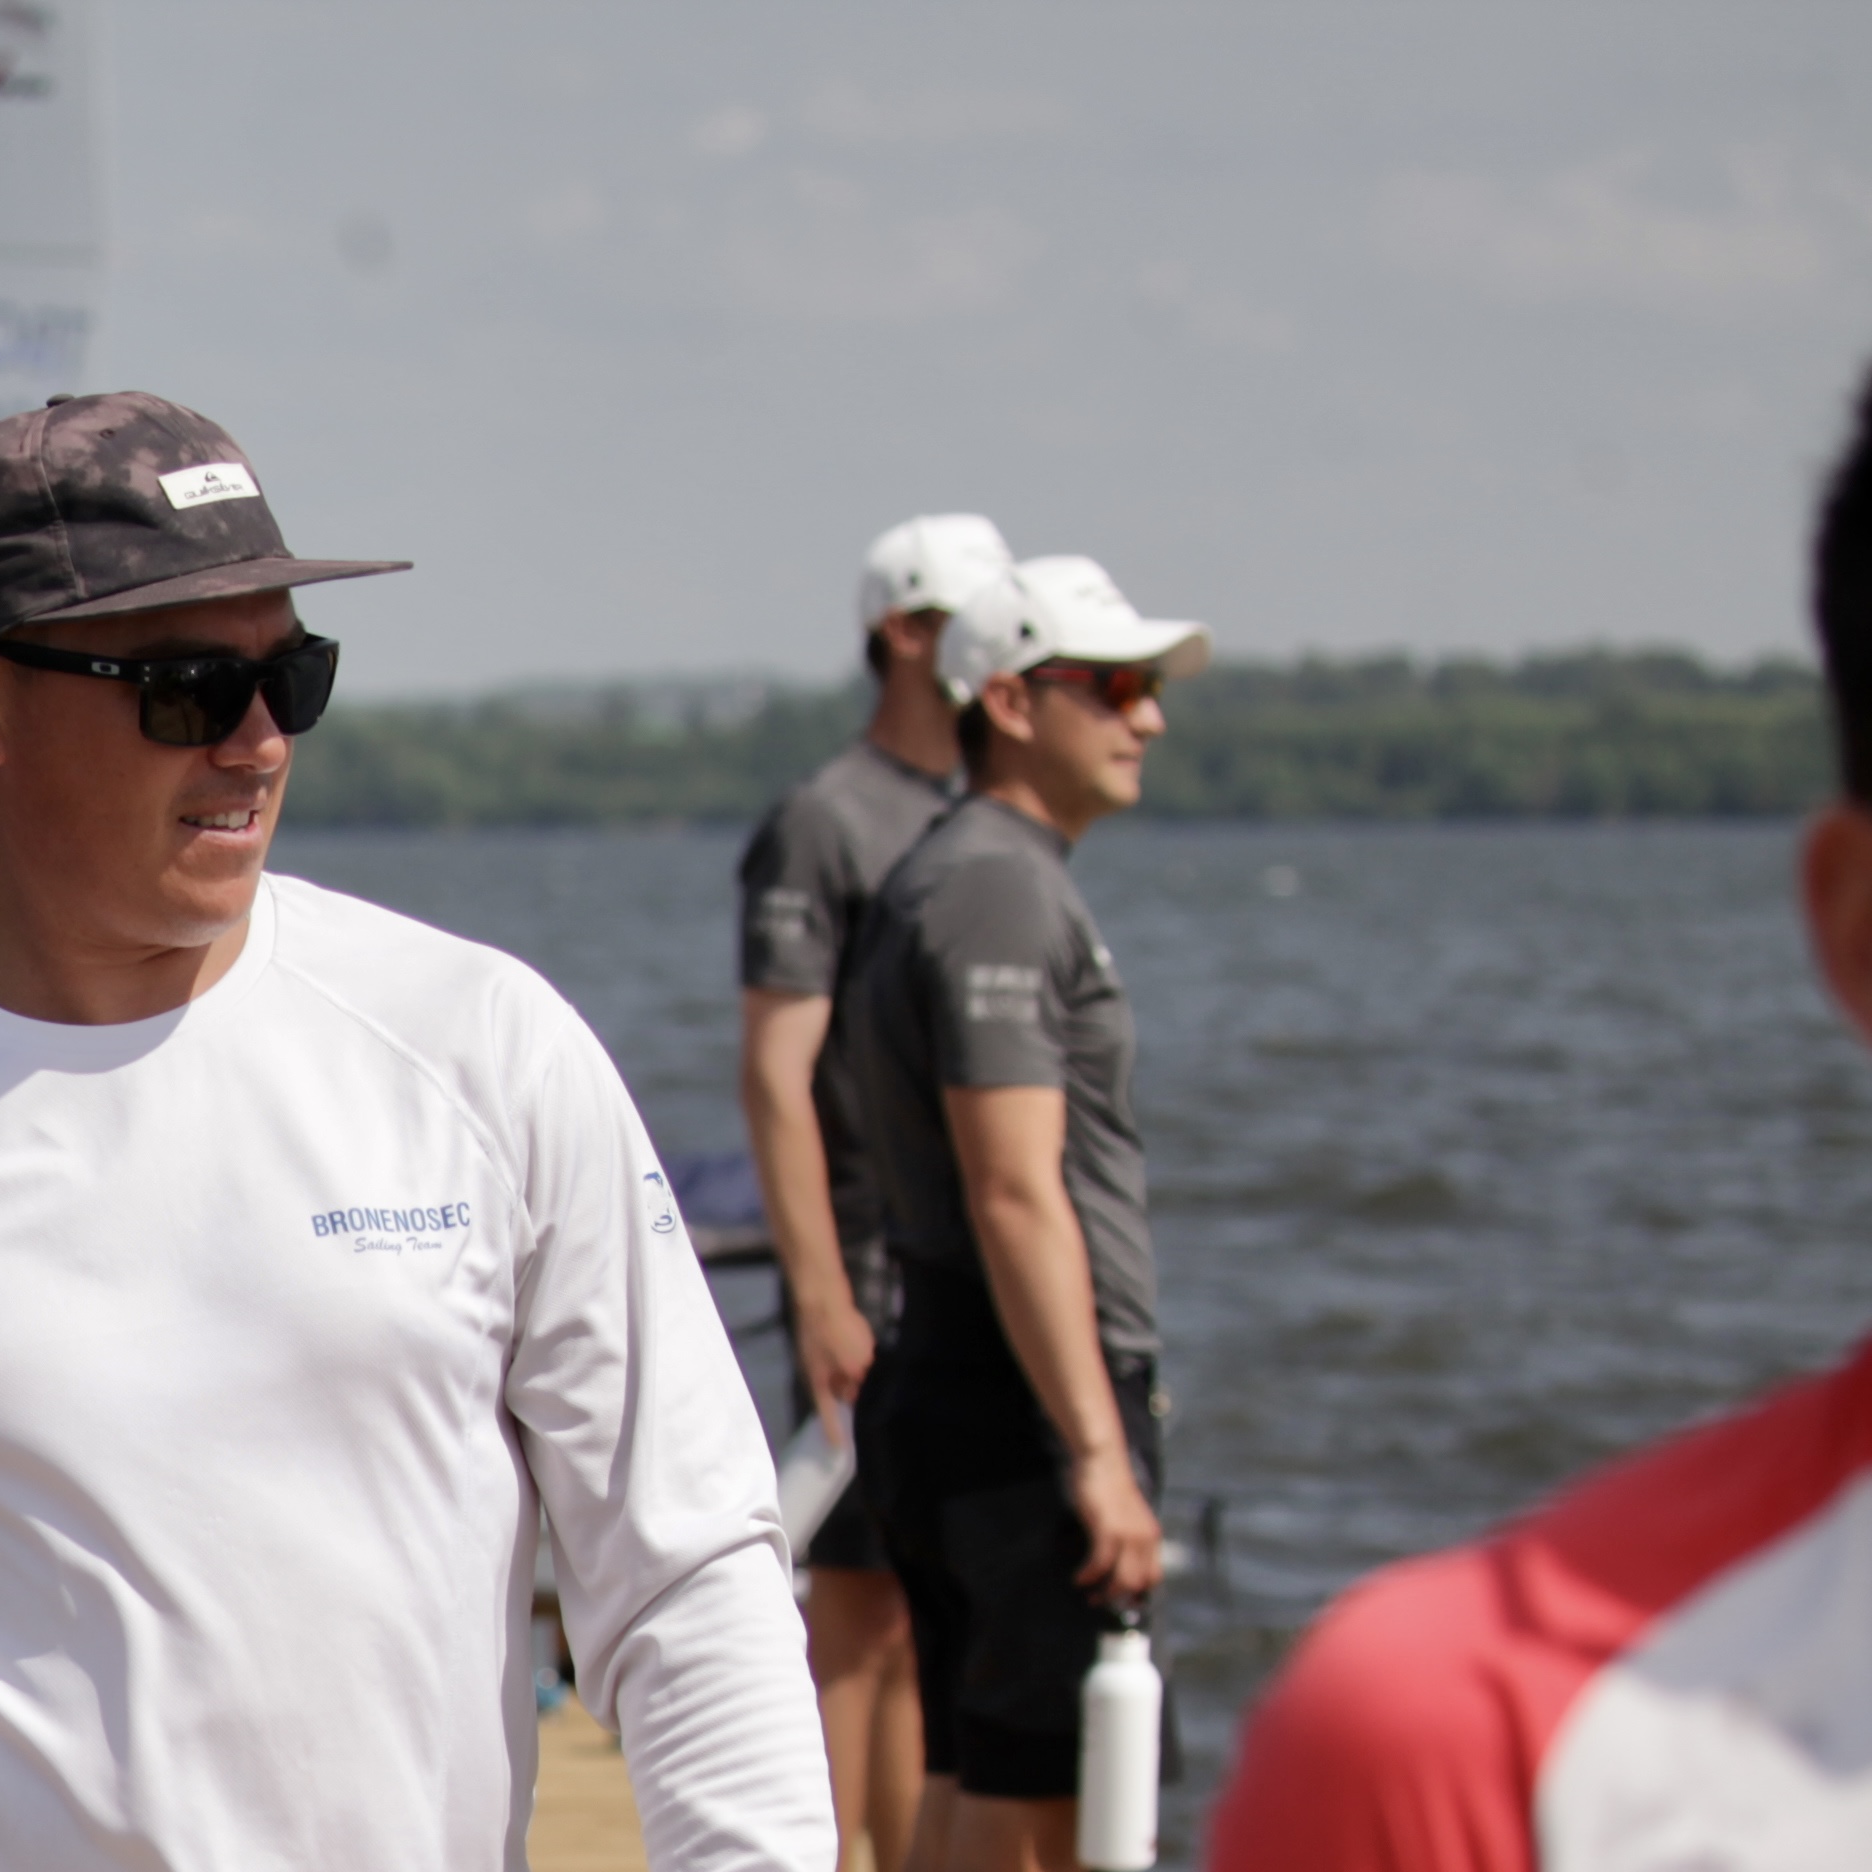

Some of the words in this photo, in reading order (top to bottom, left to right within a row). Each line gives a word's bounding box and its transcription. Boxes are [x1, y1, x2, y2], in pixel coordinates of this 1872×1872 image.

[310, 1201, 471, 1237] BRONENOSEC
[353, 1237, 402, 1256] Sailing
[406, 1236, 444, 1252] Team
